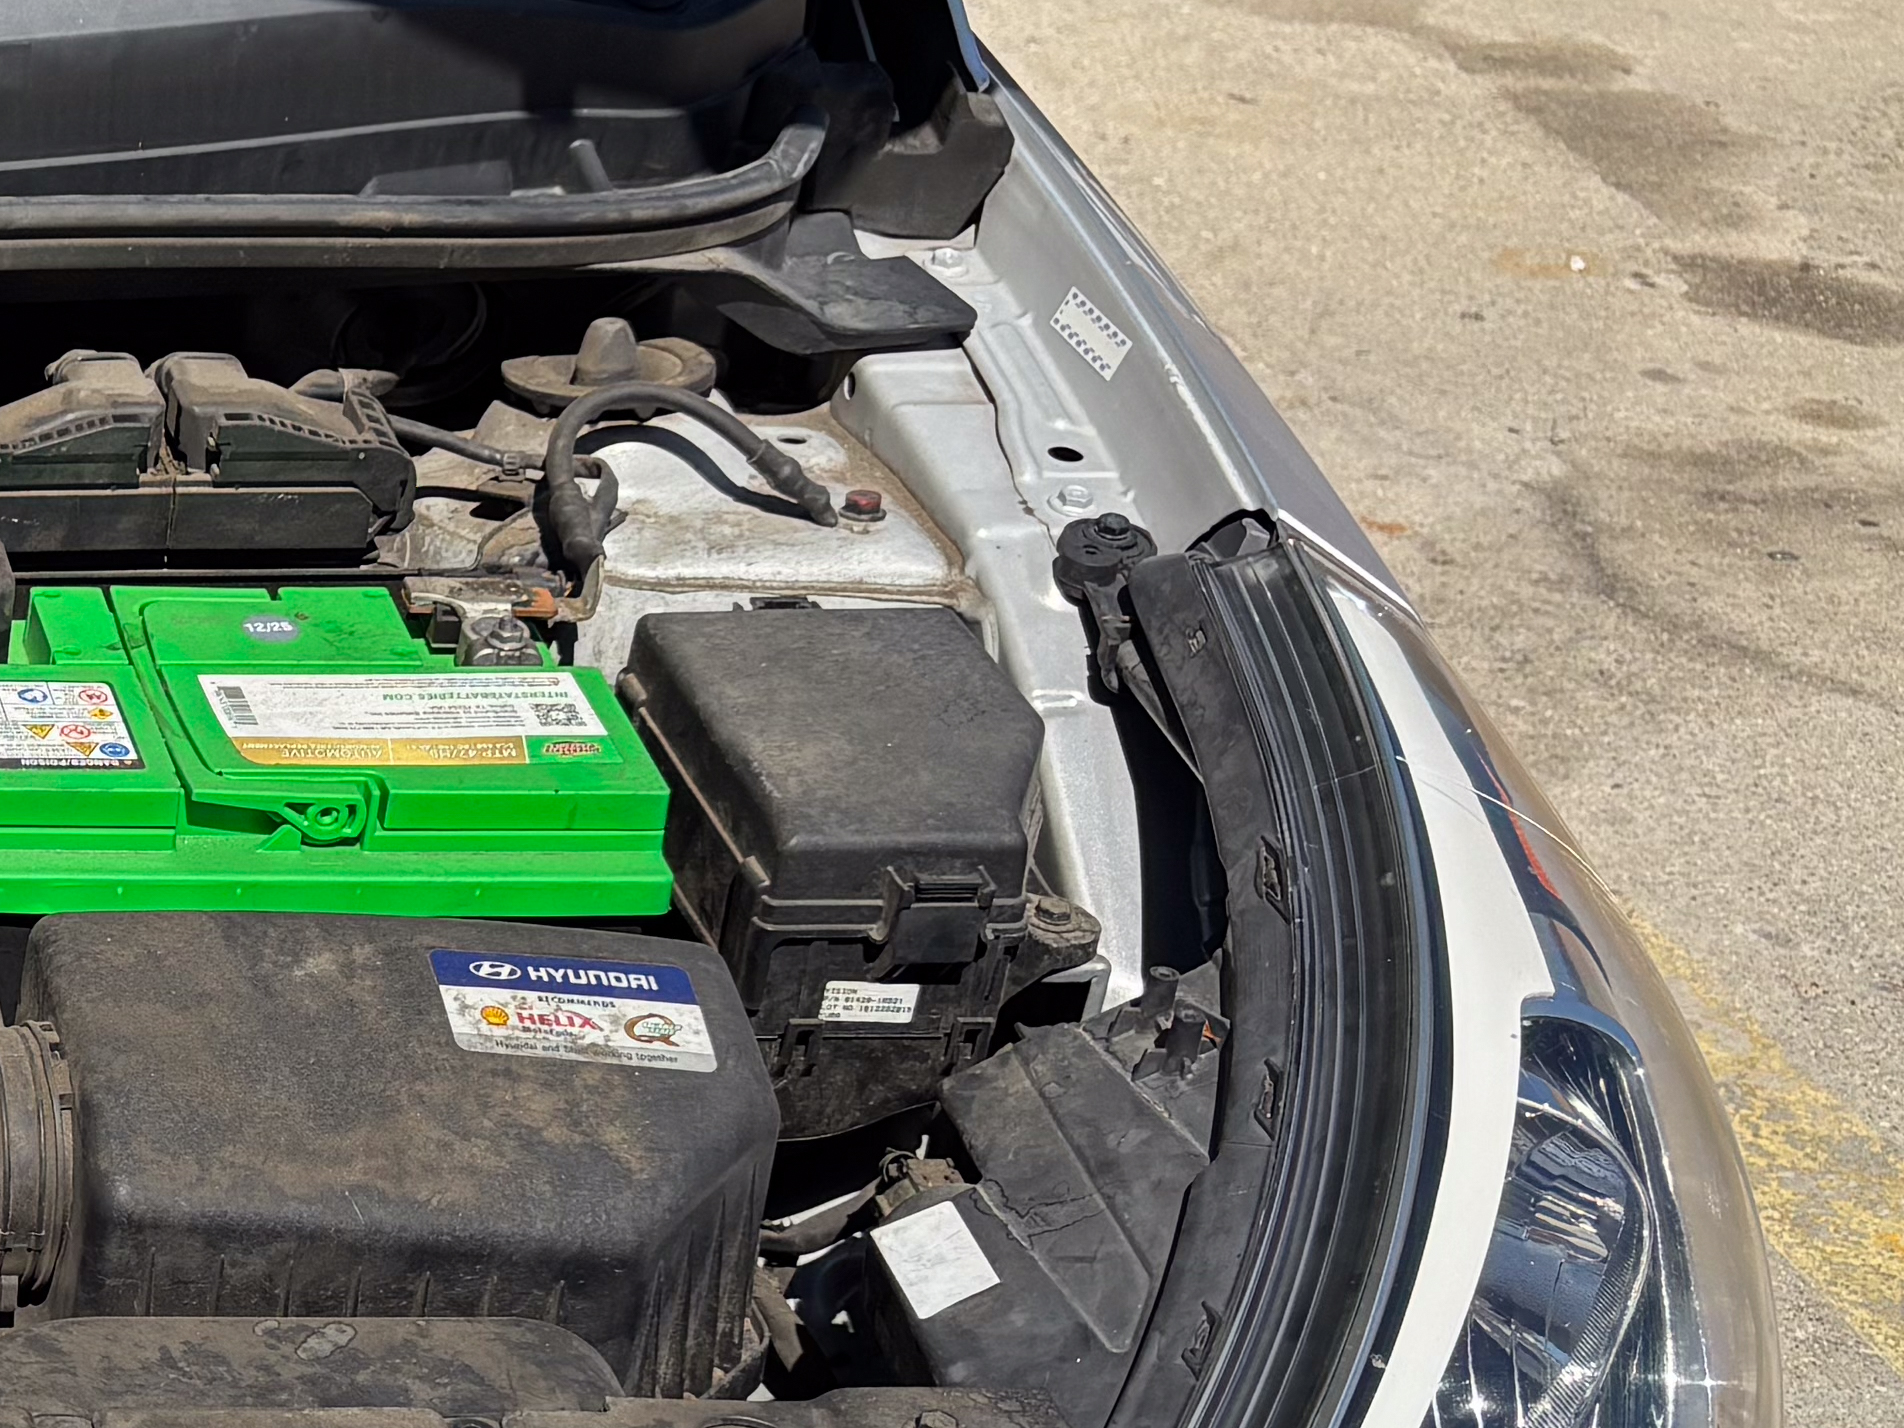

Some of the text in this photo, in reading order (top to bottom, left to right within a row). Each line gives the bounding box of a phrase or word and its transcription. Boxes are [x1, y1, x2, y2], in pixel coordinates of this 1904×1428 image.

[243, 621, 294, 633] 12/25
[280, 747, 382, 759] AUTOMOTIVE
[526, 965, 659, 991] HYUNDAI
[515, 1008, 600, 1031] HELIX
